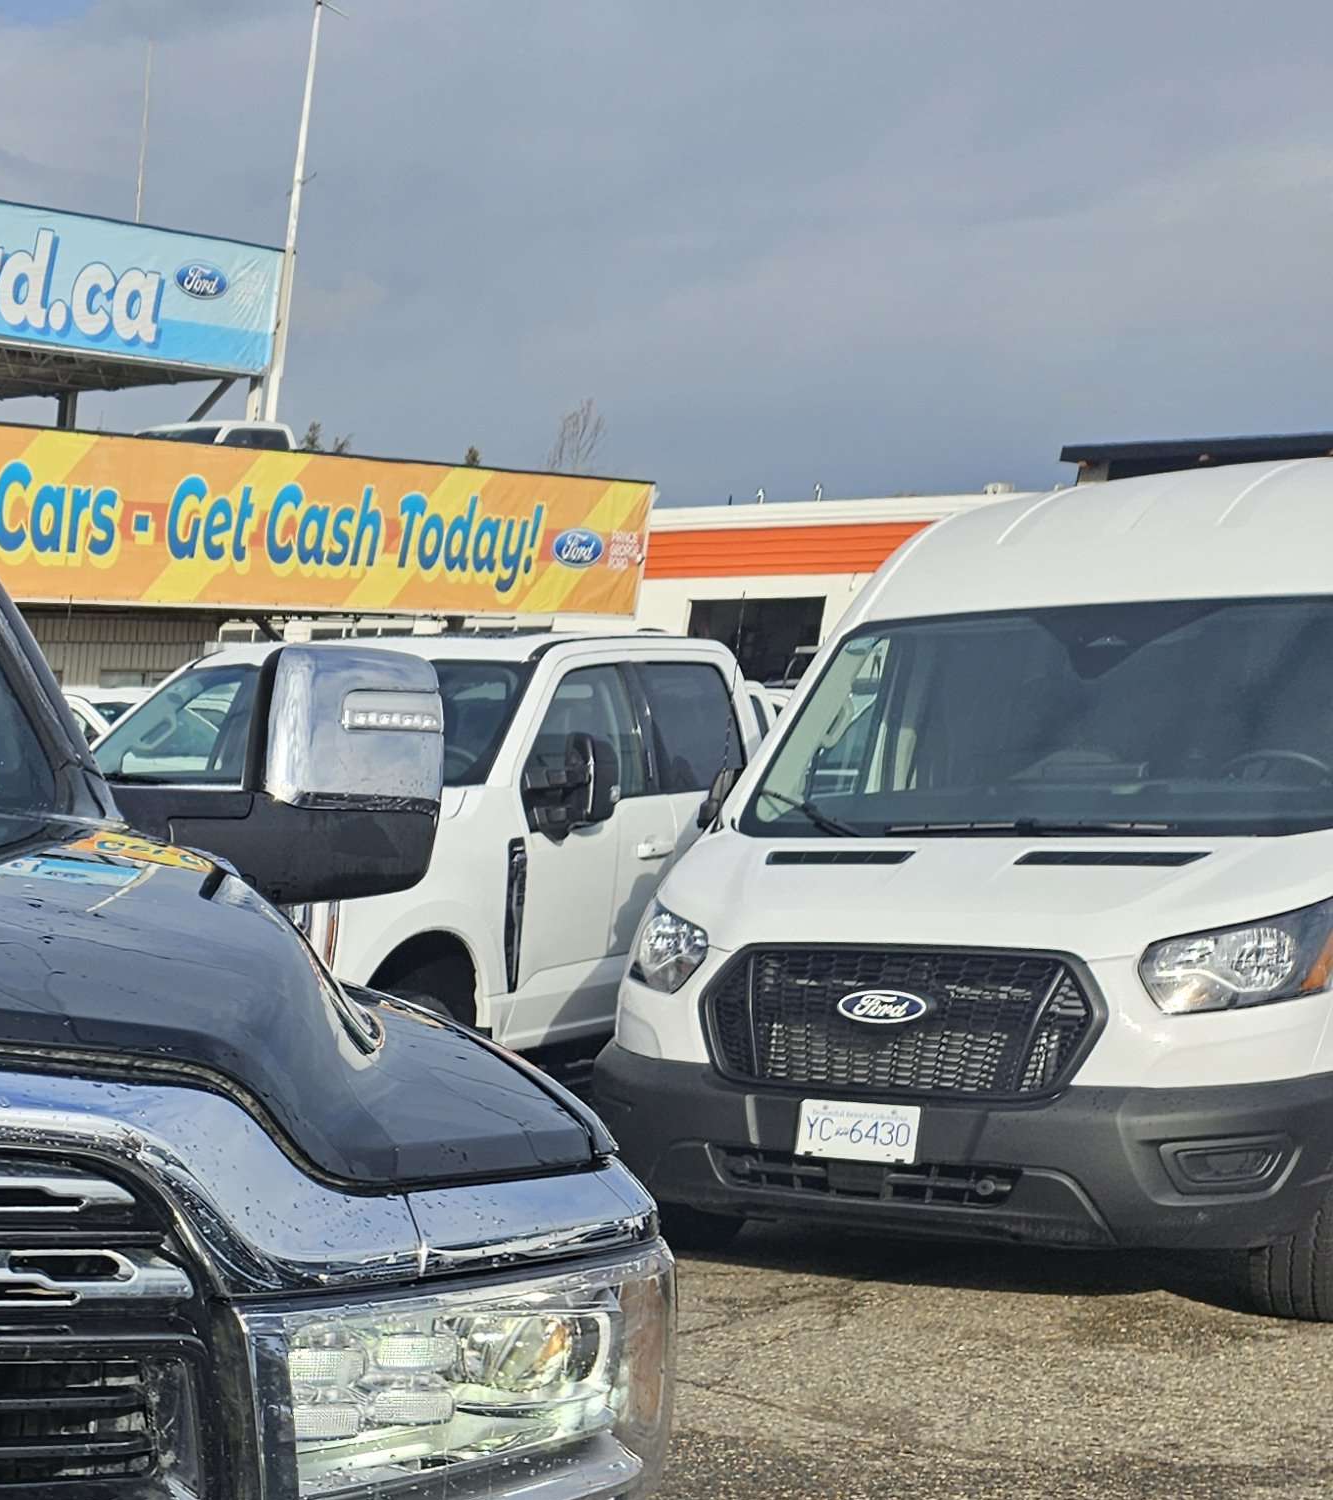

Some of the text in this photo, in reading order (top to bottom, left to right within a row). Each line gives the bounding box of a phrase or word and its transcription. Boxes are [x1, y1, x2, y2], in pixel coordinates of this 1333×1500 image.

[181, 262, 221, 296] Ford
[167, 476, 255, 562] Get
[266, 483, 383, 568] Cash
[396, 493, 546, 593] Today!
[558, 532, 598, 563] Ford
[849, 993, 913, 1019] Ford
